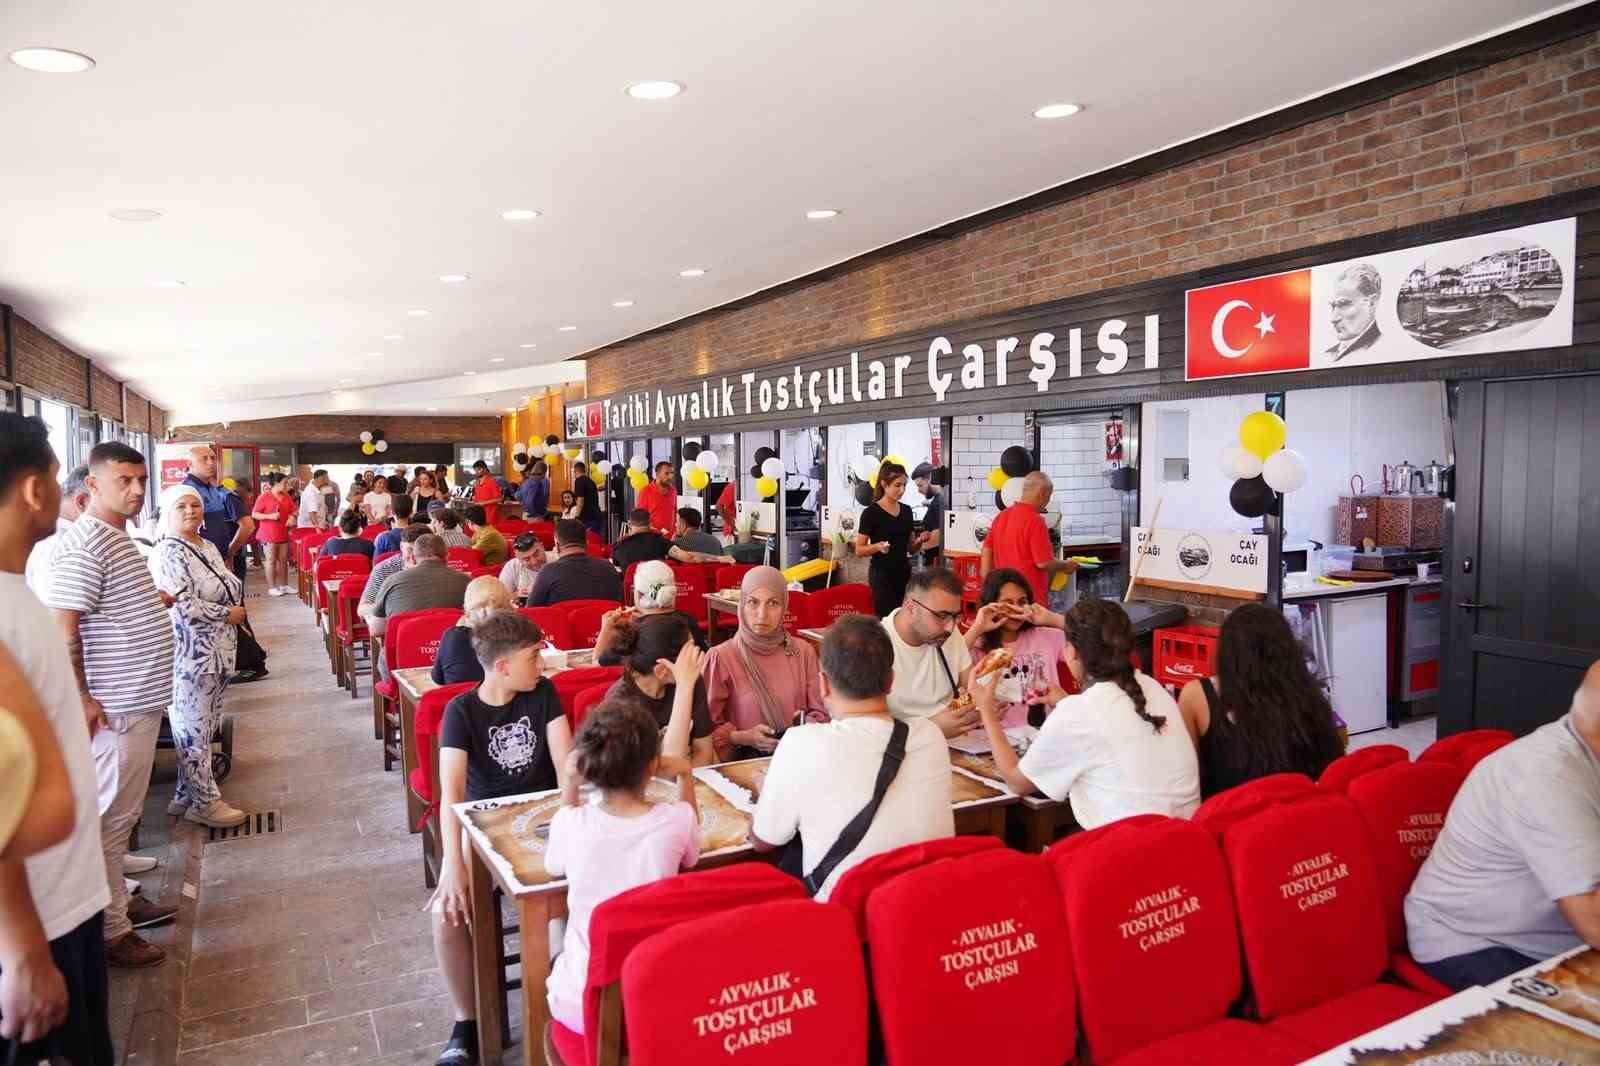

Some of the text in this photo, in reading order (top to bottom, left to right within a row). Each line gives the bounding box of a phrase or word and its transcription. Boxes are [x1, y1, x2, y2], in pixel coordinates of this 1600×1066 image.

[602, 314, 1159, 431] Tarihi Ayvalık Tostçular Çarşısı
[949, 514, 956, 529] F
[1230, 553, 1258, 566] OCAĞI
[1239, 540, 1258, 550] ÇAY
[1280, 863, 1349, 899] TOSTÇULAR
[1134, 885, 1182, 914] AYVALIK
[960, 918, 1016, 946] AYVALIK
[1119, 896, 1201, 939] TOSTÇULAR
[940, 932, 1038, 973] TOSTÇULAR
[1140, 921, 1185, 952] ÇARŞISI
[719, 971, 792, 1006] AYVALIK
[964, 959, 1019, 990] ÇARŞISI
[693, 988, 818, 1037] TOSTÇULAR
[723, 1018, 792, 1055] ÇARŞISI
